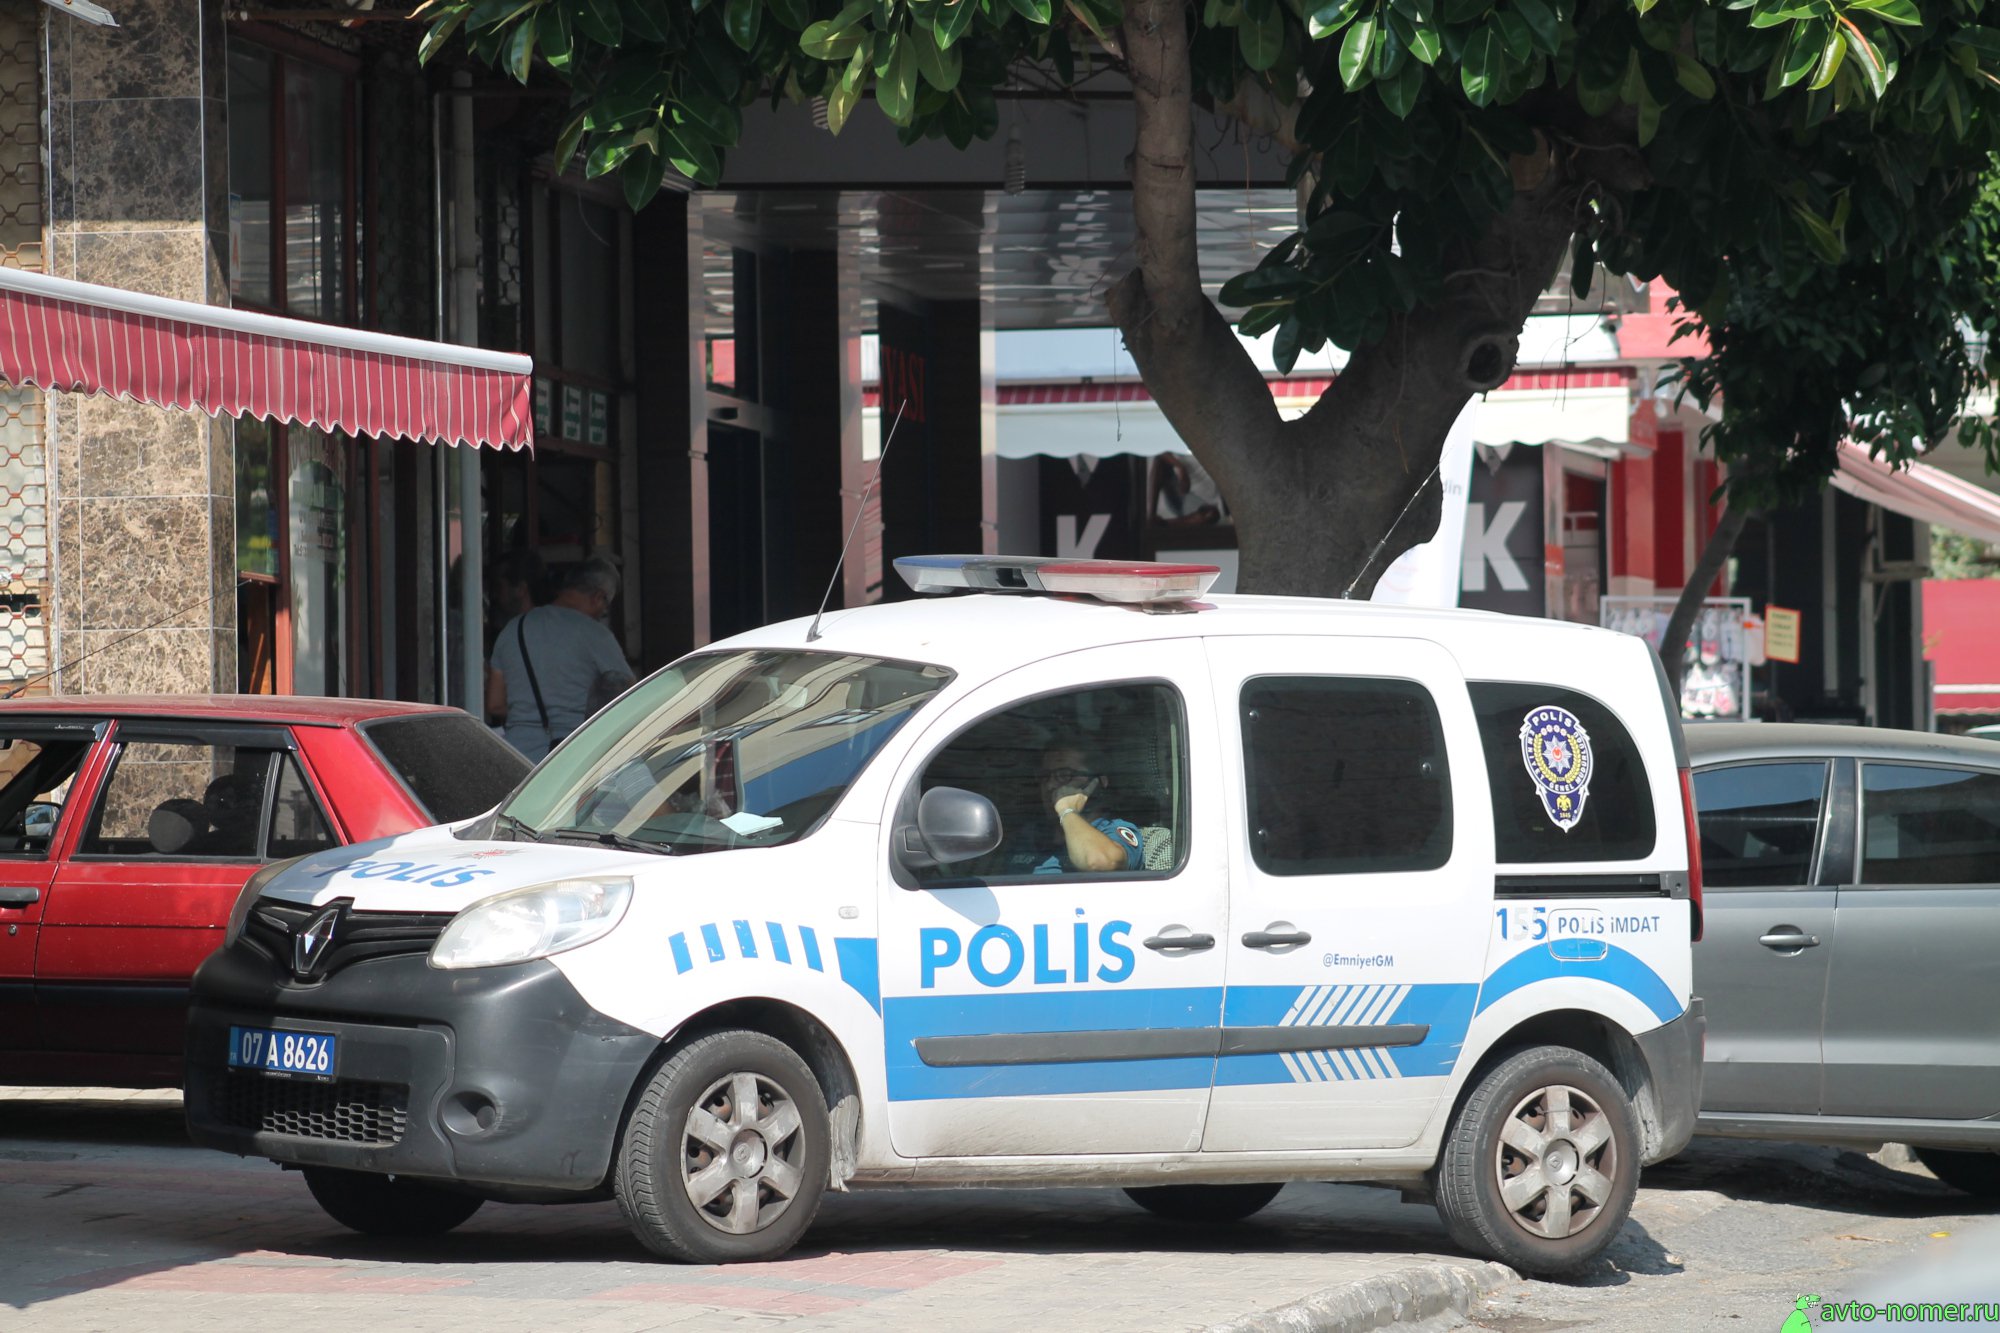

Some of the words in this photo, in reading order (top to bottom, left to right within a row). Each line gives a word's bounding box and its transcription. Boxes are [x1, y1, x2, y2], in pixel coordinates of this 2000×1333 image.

[880, 344, 926, 423] YASI
[313, 861, 496, 887] POLİS
[1496, 906, 1548, 941] 155
[919, 907, 1136, 989] POLİS
[1322, 952, 1394, 970] @EmniyetGM
[242, 1032, 263, 1065] 07
[265, 1034, 279, 1067] A
[283, 1035, 329, 1071] 8626
